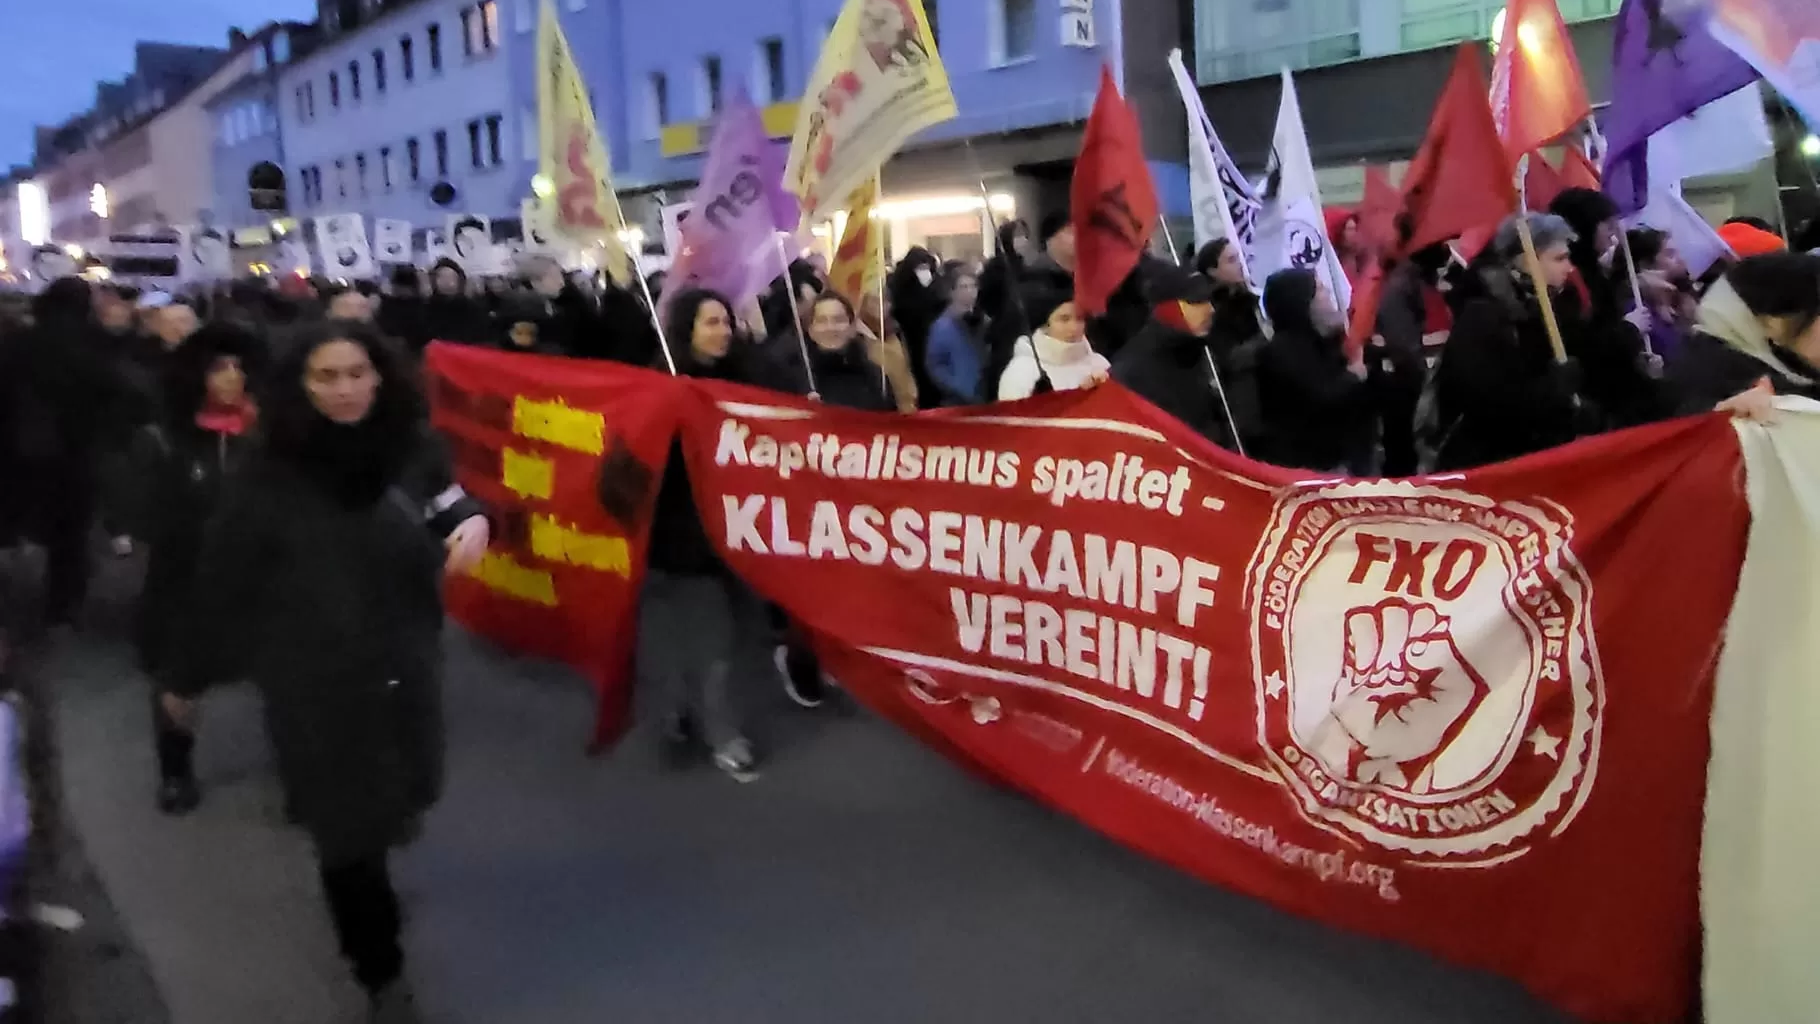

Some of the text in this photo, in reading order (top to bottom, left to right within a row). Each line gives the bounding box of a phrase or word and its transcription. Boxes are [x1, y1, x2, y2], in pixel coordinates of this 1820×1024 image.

[714, 418, 1020, 489] Kapitalismus
[1032, 451, 1192, 517] spaltet
[723, 494, 1221, 629] KLASSENKAMPF
[1264, 505, 1333, 629] FÖDERATION
[1347, 532, 1488, 602] FKO
[950, 587, 1213, 722] VEREINT!
